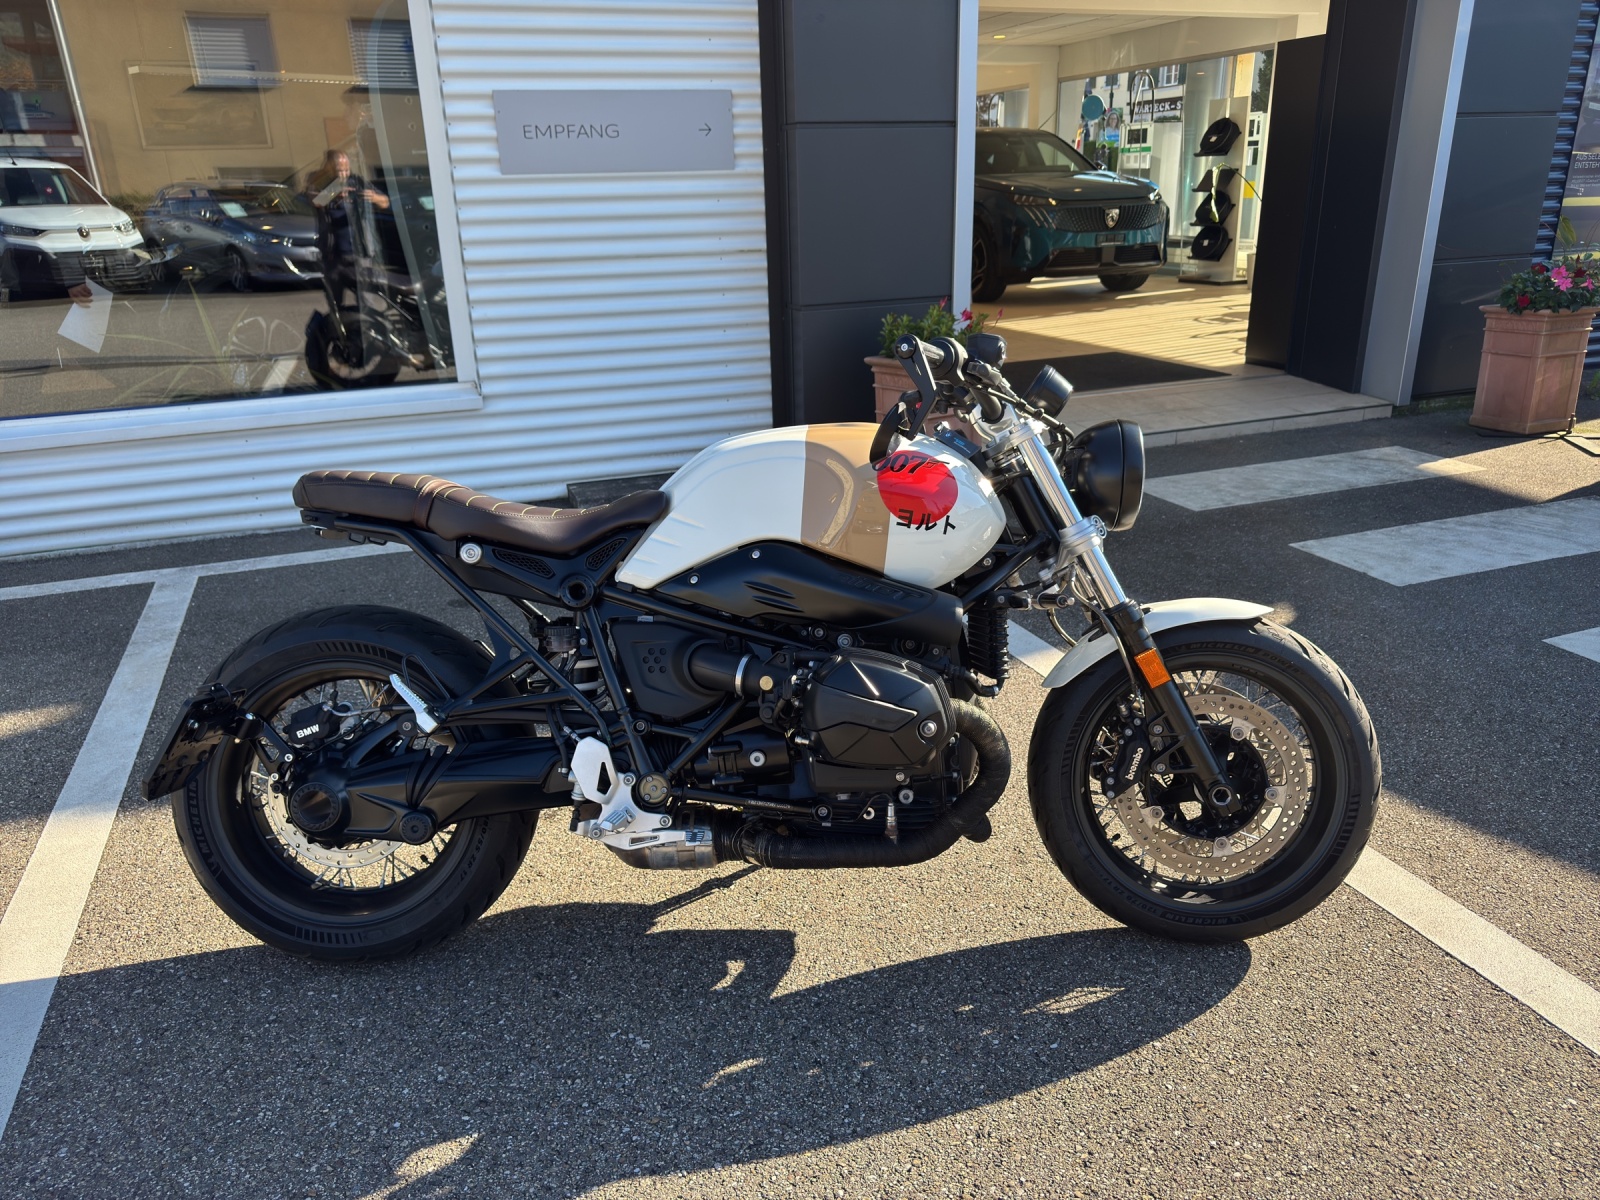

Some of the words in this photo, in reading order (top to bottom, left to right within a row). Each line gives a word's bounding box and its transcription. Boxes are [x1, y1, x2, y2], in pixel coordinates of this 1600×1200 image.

[522, 123, 620, 140] EMPFANG
[896, 508, 957, 535] ヨルト
[296, 724, 320, 739] BMW
[1124, 747, 1144, 781] brembo
[187, 780, 211, 853] MICHELIN
[1164, 912, 1229, 925] MICHELIN
